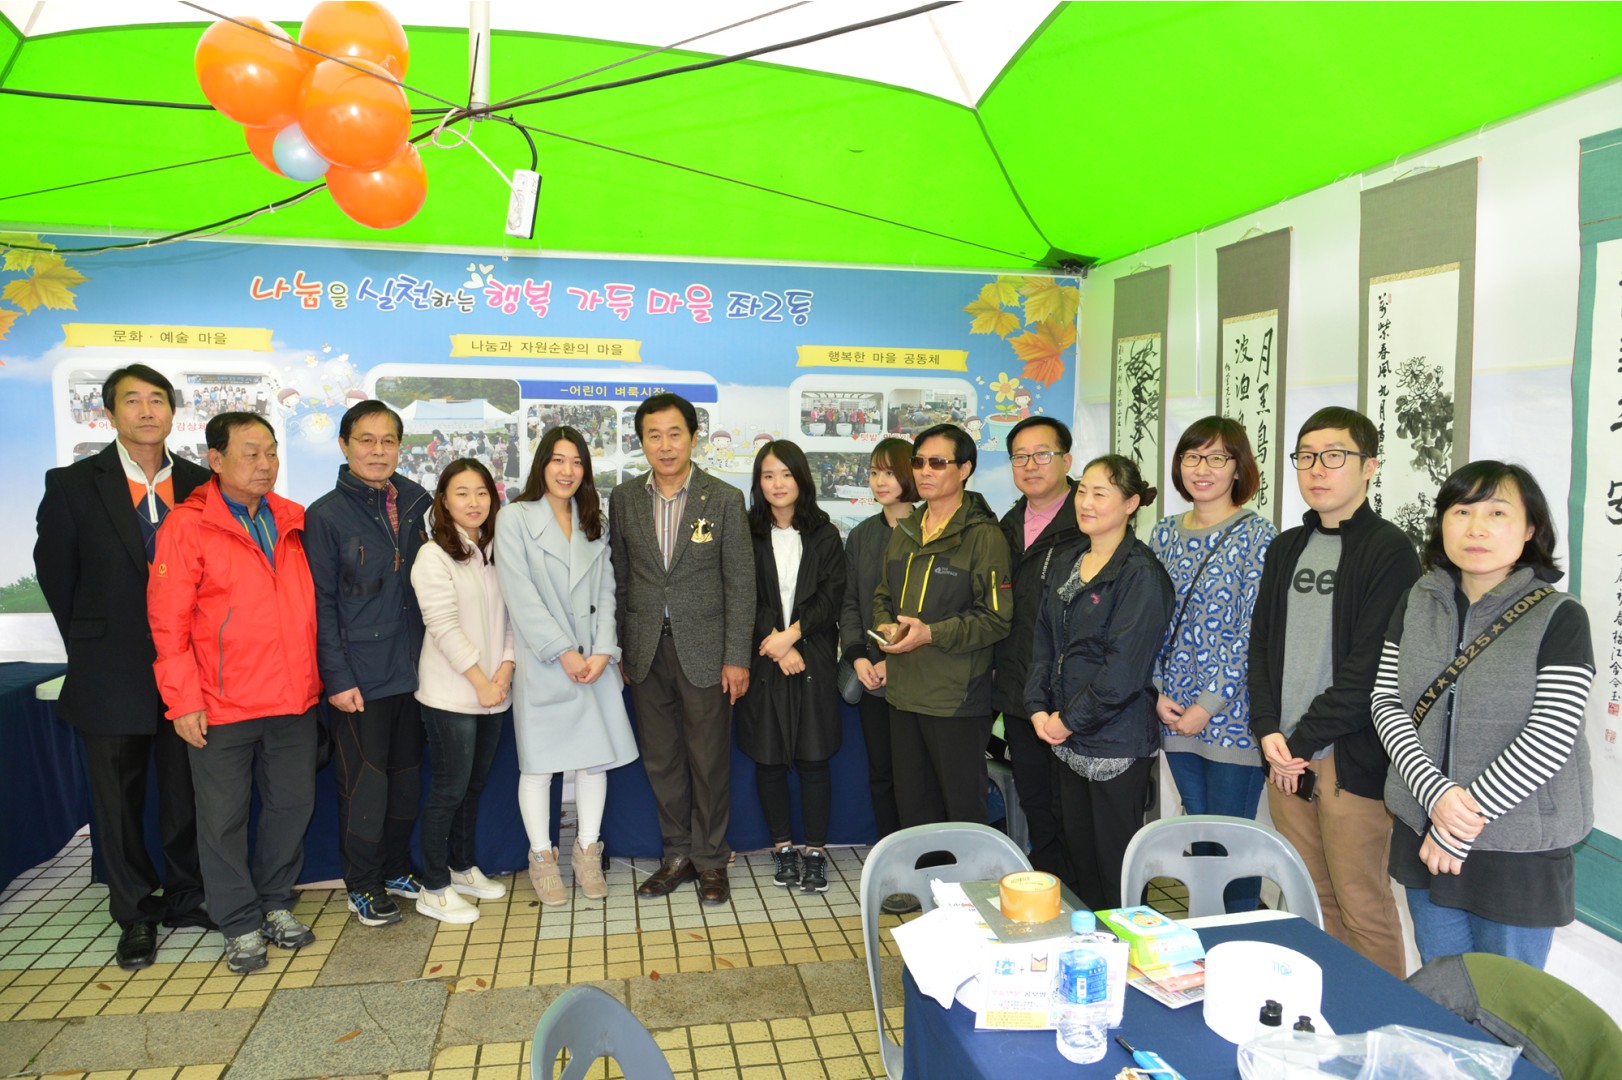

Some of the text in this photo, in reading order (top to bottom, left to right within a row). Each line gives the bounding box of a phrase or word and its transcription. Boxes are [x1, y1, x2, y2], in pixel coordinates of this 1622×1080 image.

[251, 271, 813, 326] 나눔을 실천하는 행복 가득 마을 좌2동
[112, 329, 228, 345] 문화 예술 마을
[471, 340, 624, 356] 나눔과 자원순환의 마을
[828, 350, 940, 366] 행복한 마을 공동체
[1446, 633, 1492, 676] 1925
